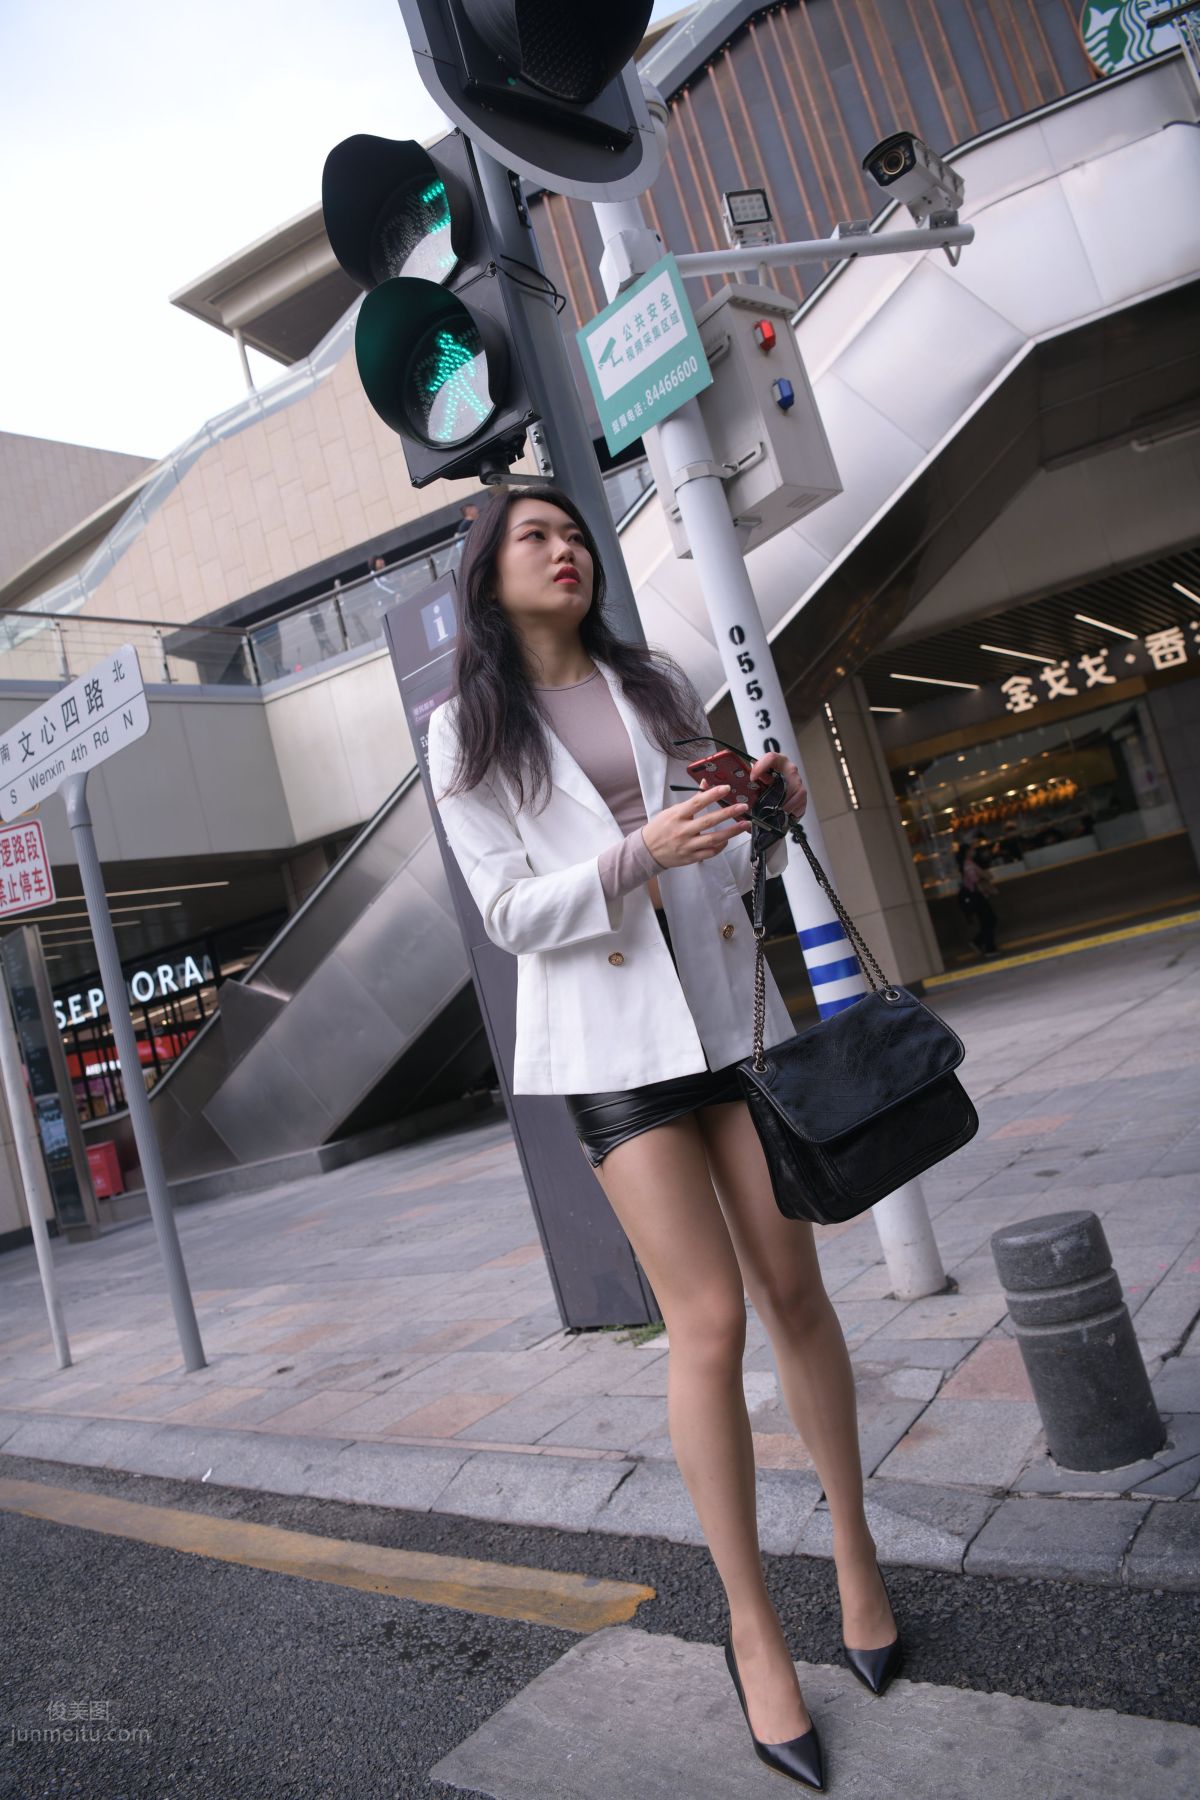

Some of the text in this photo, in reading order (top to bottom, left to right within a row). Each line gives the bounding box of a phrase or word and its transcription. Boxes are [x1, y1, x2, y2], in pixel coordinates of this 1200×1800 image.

[622, 292, 672, 342] 公共安全
[625, 310, 680, 361] 视频采集区域
[1001, 620, 1200, 713] 金戈戈·香
[0, 659, 125, 765] 南 文心四路 北
[10, 709, 134, 805] S Wenxin 4th Rd N
[0, 831, 39, 869] 逻路段
[53, 955, 204, 1030] SEPORA
